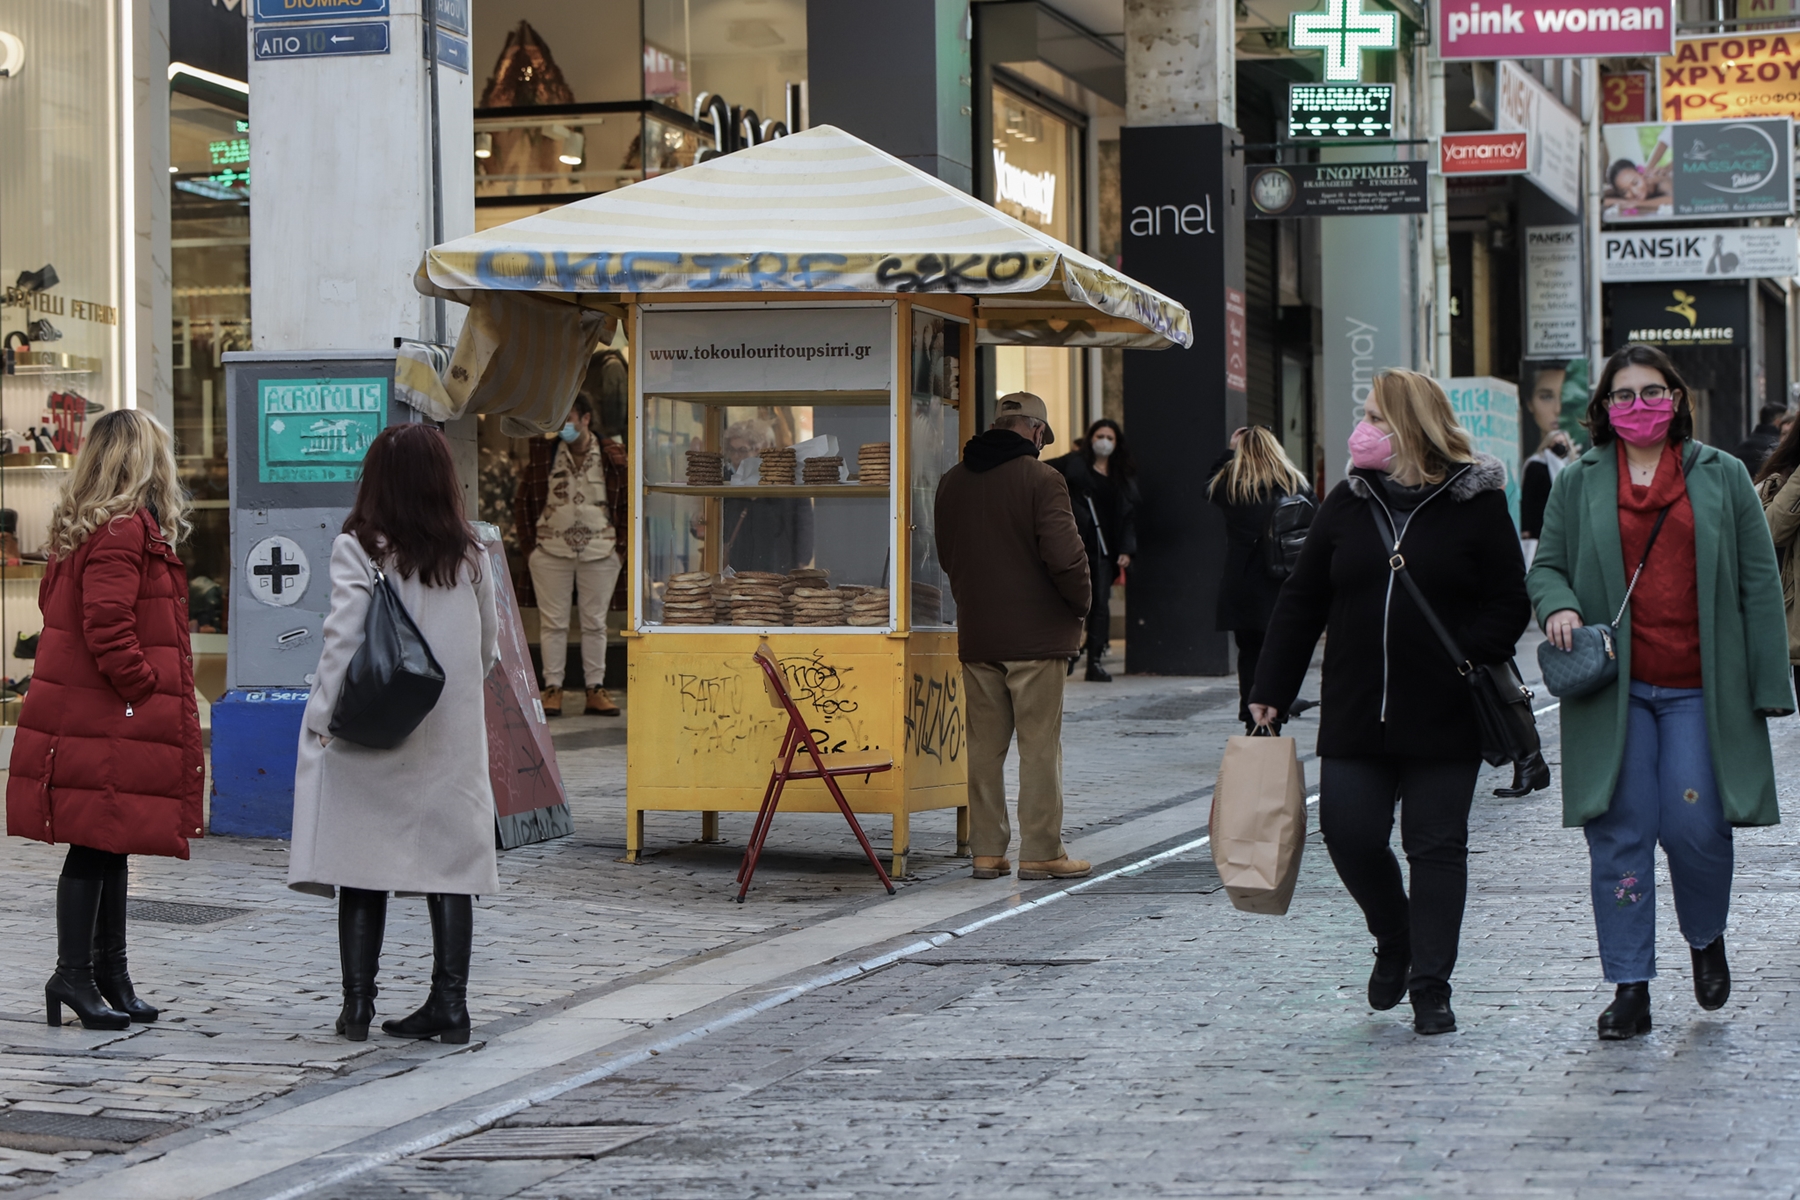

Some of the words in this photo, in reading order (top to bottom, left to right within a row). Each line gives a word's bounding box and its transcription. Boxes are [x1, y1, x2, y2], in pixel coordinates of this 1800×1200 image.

[1448, 3, 1524, 42] pink
[1533, 6, 1665, 33] woman
[261, 37, 300, 54] ΑΠΟ
[1677, 37, 1791, 64] ΑΓΟΡΑ
[1664, 61, 1800, 88] ΧΡΥΣΟΥ
[1292, 87, 1390, 111] PHARMACY
[1443, 141, 1525, 162] yamamay
[1316, 165, 1410, 180] ΓΝΩΡΙΜΙΕΣ
[1683, 159, 1767, 173] MASSAGE
[1130, 193, 1216, 236] anel
[1628, 327, 1734, 341] MEDICOSMETIC
[650, 343, 872, 361] www.tokoulouritoupsirri.gr
[267, 386, 380, 411] ACROPOLIS
